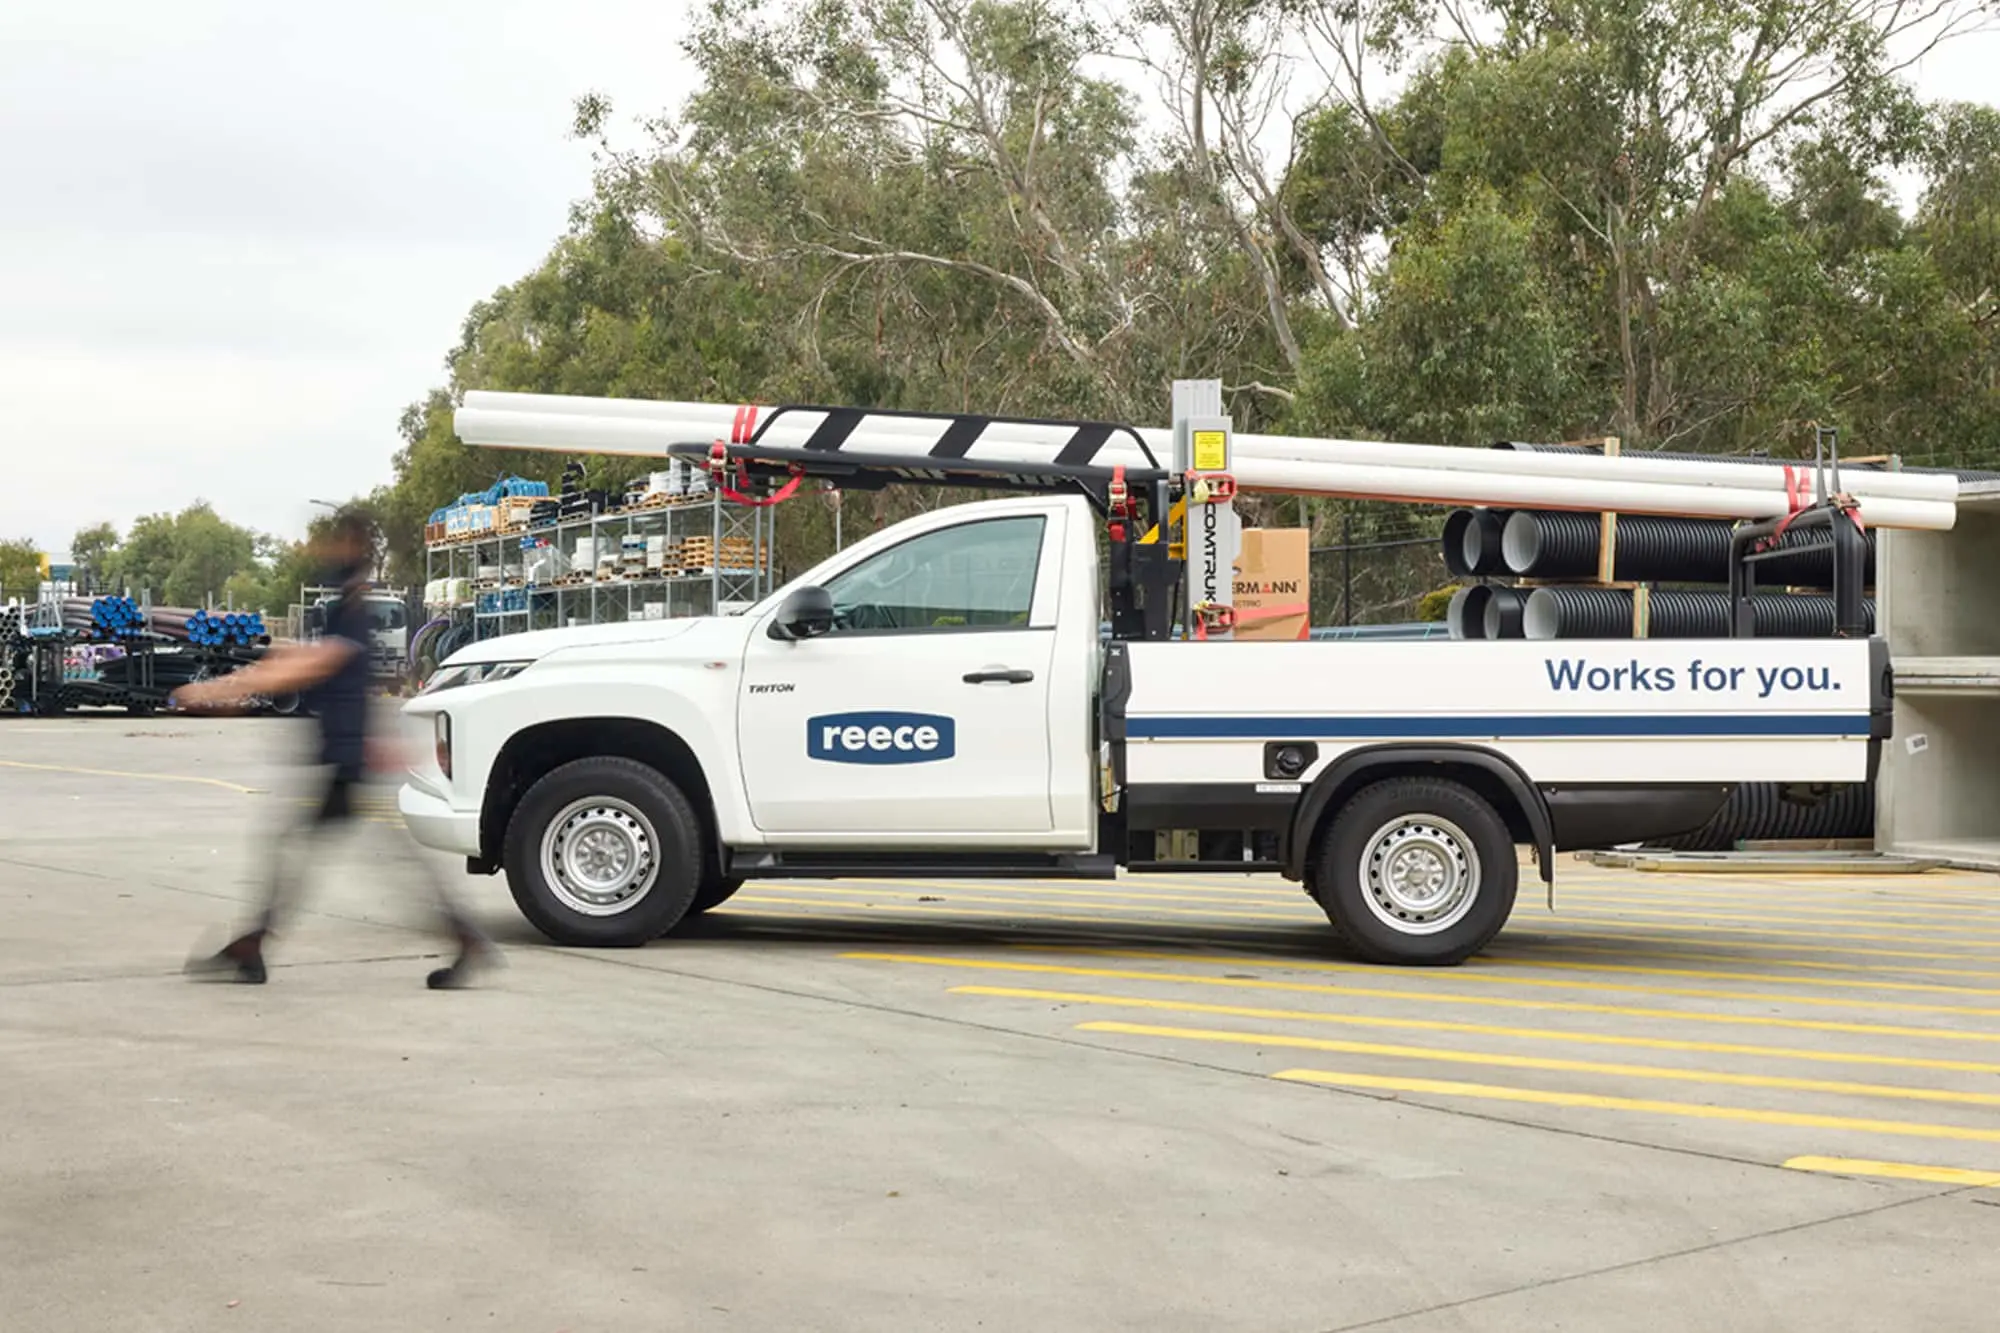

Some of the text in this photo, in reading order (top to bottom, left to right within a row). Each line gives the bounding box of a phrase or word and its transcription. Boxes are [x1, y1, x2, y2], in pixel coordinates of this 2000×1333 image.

[1204, 503, 1216, 602] COMTRUK
[749, 683, 796, 693] TRITON
[1545, 659, 1841, 698] Works for you.
[823, 726, 939, 750] reece
